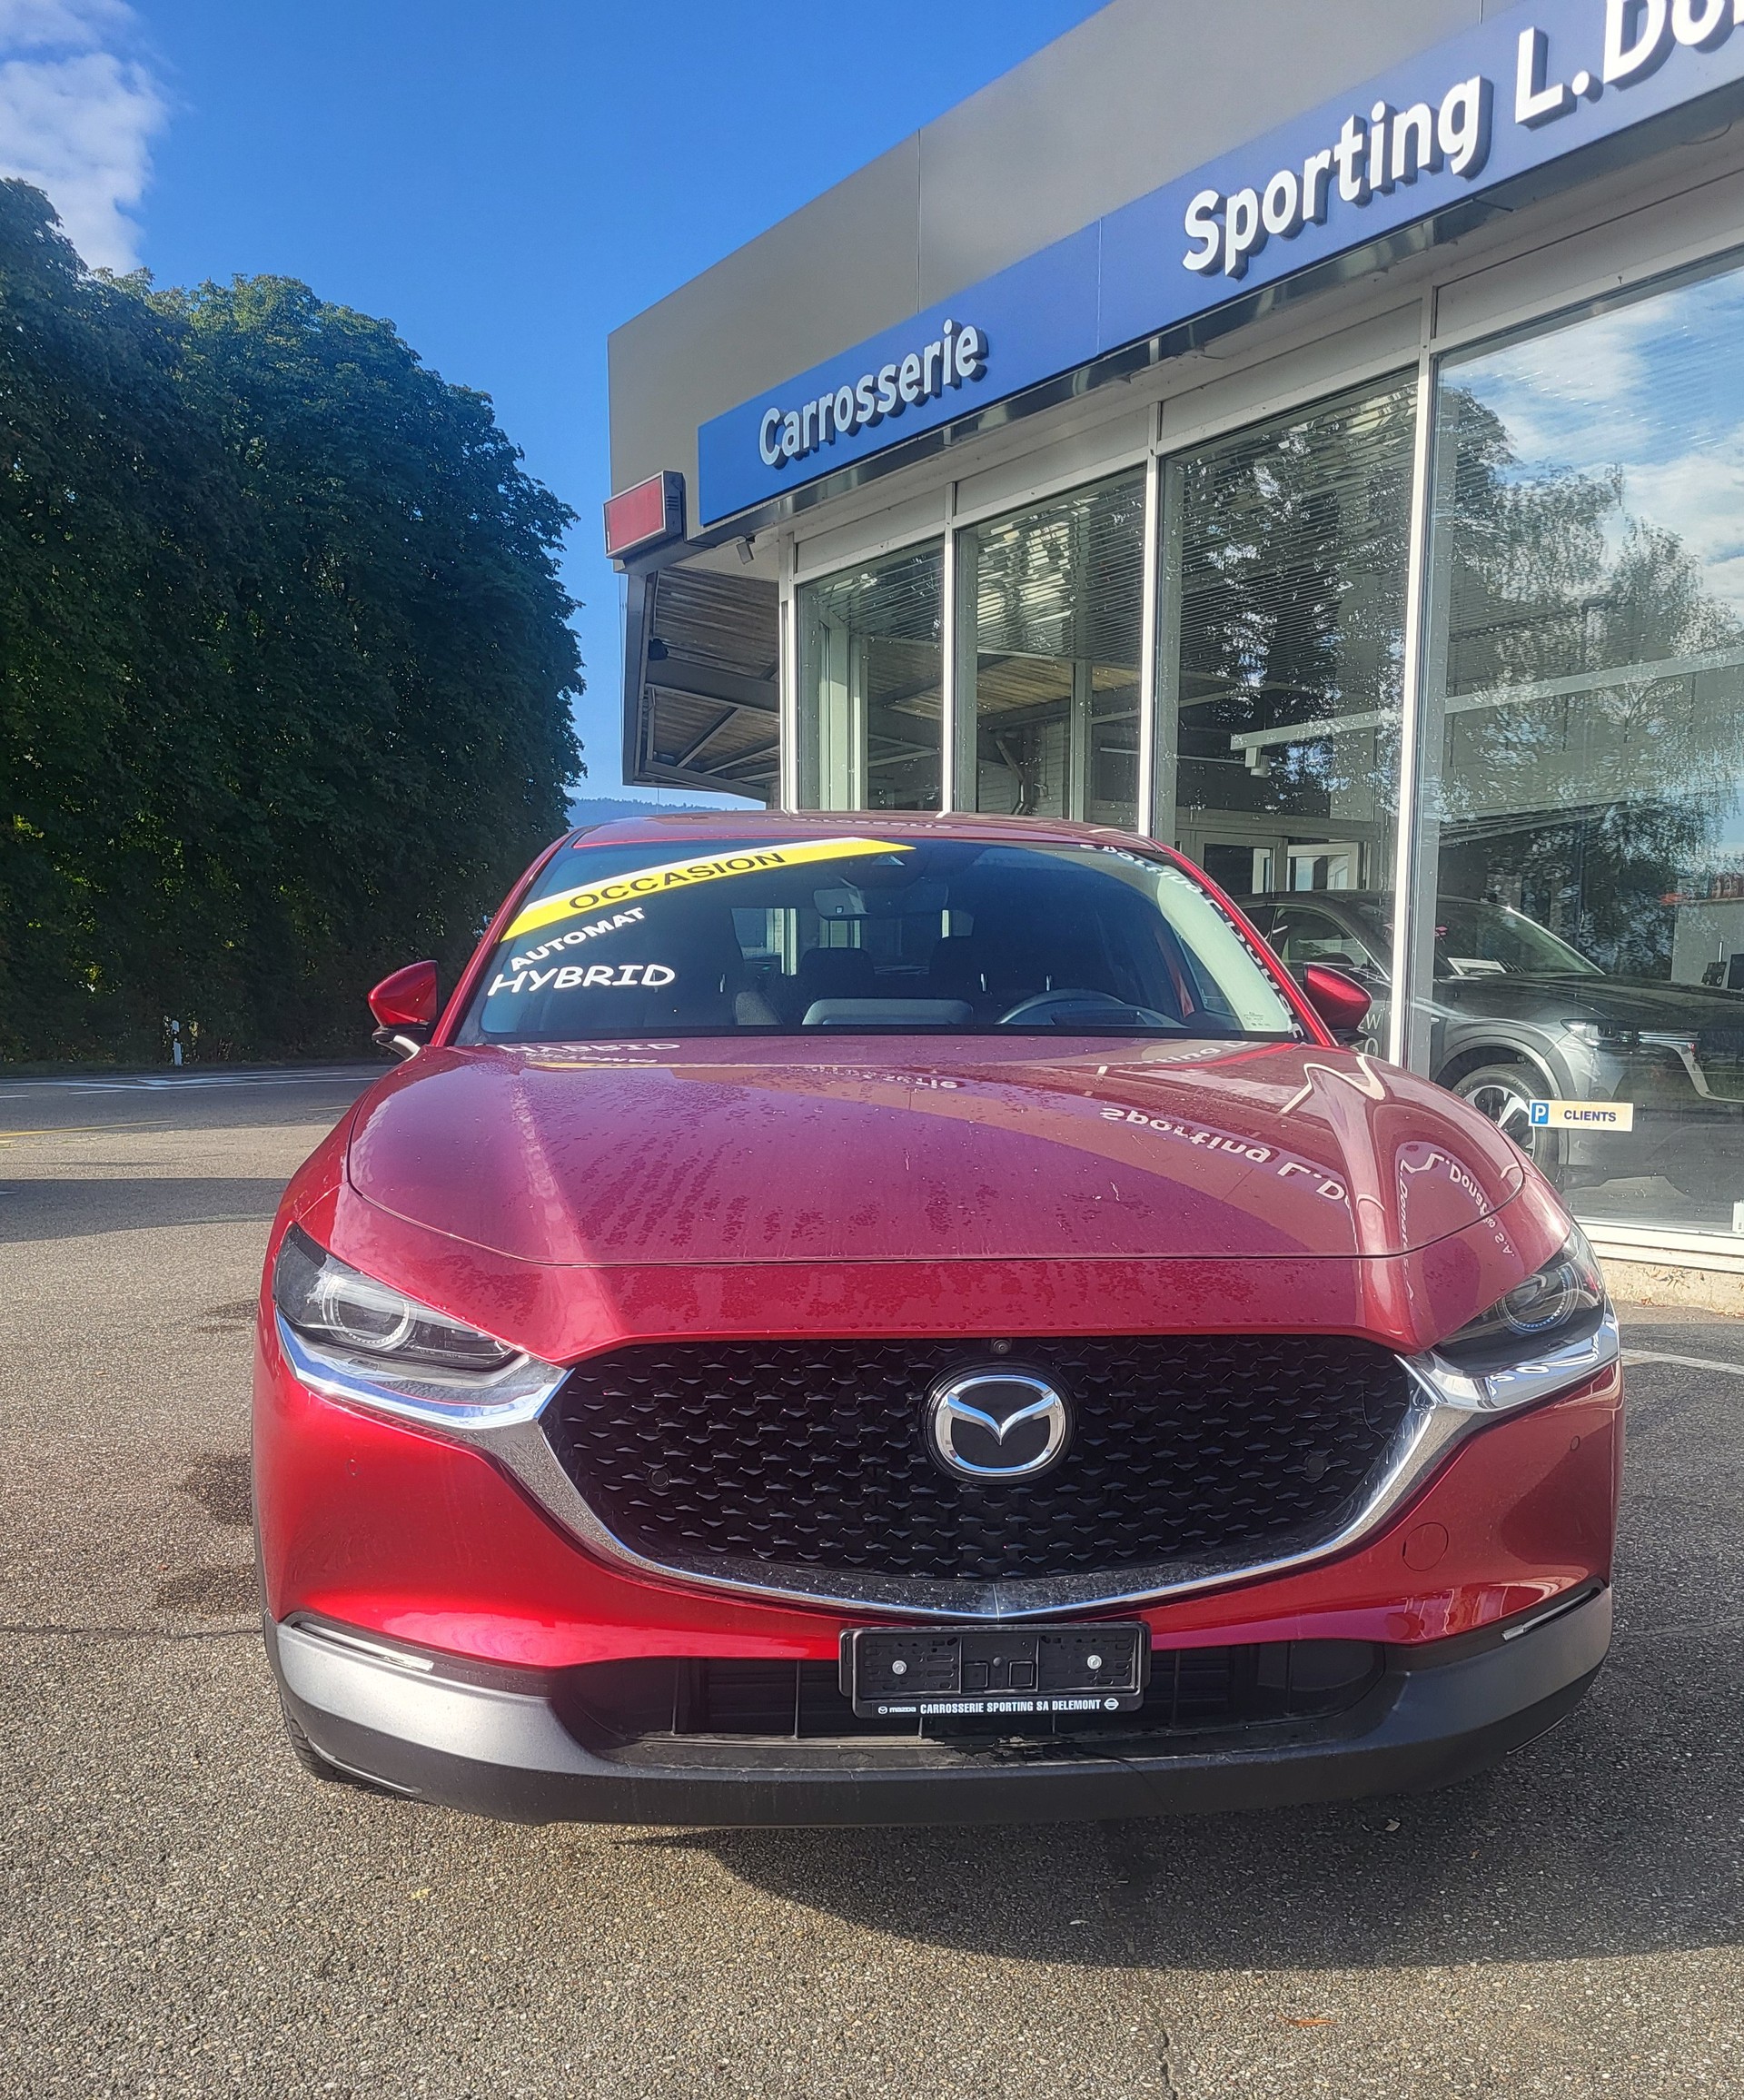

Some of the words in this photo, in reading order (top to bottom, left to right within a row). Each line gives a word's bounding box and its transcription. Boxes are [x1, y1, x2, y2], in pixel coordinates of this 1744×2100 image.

[1183, 74, 1483, 276] Sporting
[759, 318, 982, 467] Carrosserie
[569, 852, 786, 910] OCCASION
[511, 906, 647, 972] AUTOMAT
[487, 964, 676, 997] HYBRID
[1563, 1110, 1617, 1122] CLIENTS
[920, 1702, 985, 1714] CARROSSERIE
[986, 1700, 1034, 1713] SPORTING
[1036, 1700, 1050, 1711] SA
[1052, 1699, 1102, 1710] DELEMONT
